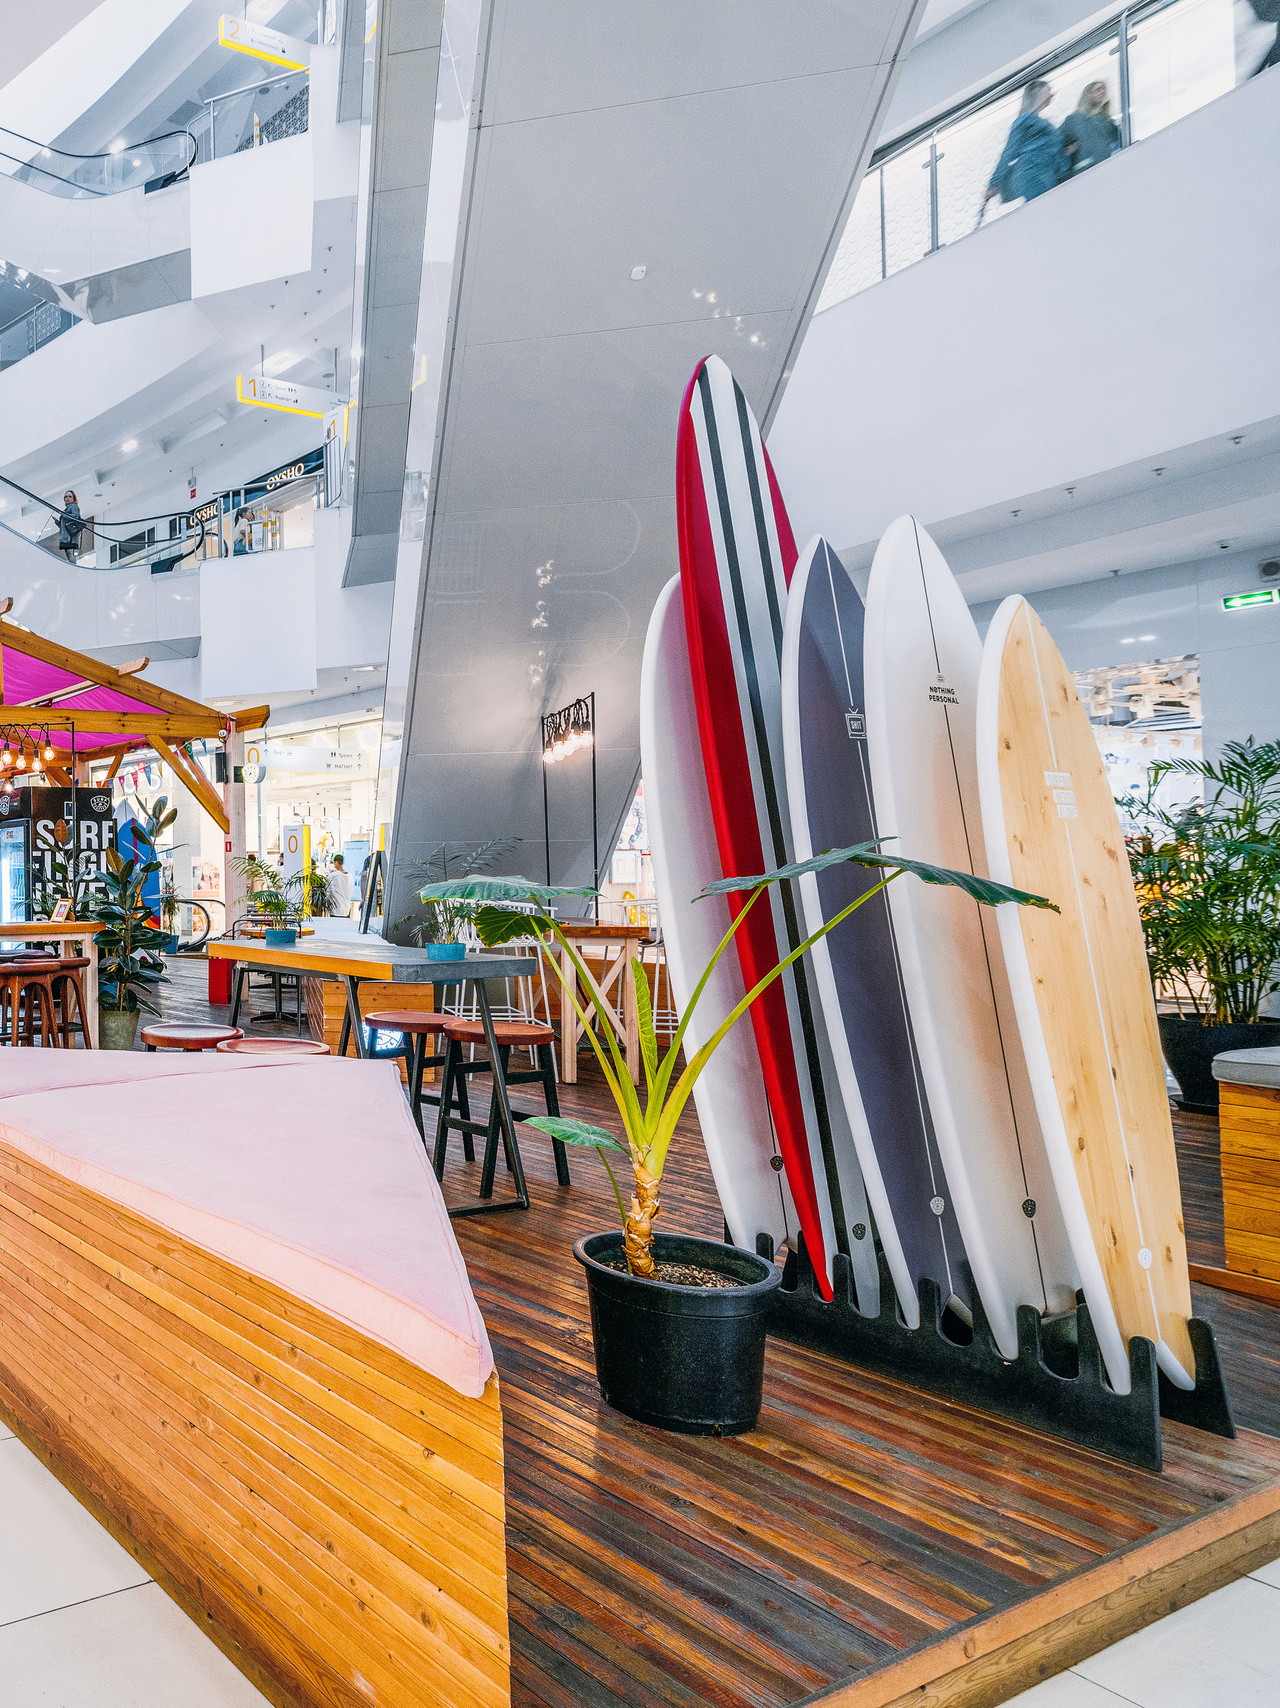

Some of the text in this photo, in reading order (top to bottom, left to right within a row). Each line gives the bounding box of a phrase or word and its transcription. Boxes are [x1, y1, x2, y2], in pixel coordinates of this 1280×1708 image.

[229, 20, 240, 40] 2
[248, 379, 256, 397] 1
[266, 463, 305, 490] OYSHO
[928, 695, 959, 704] PERSONAL
